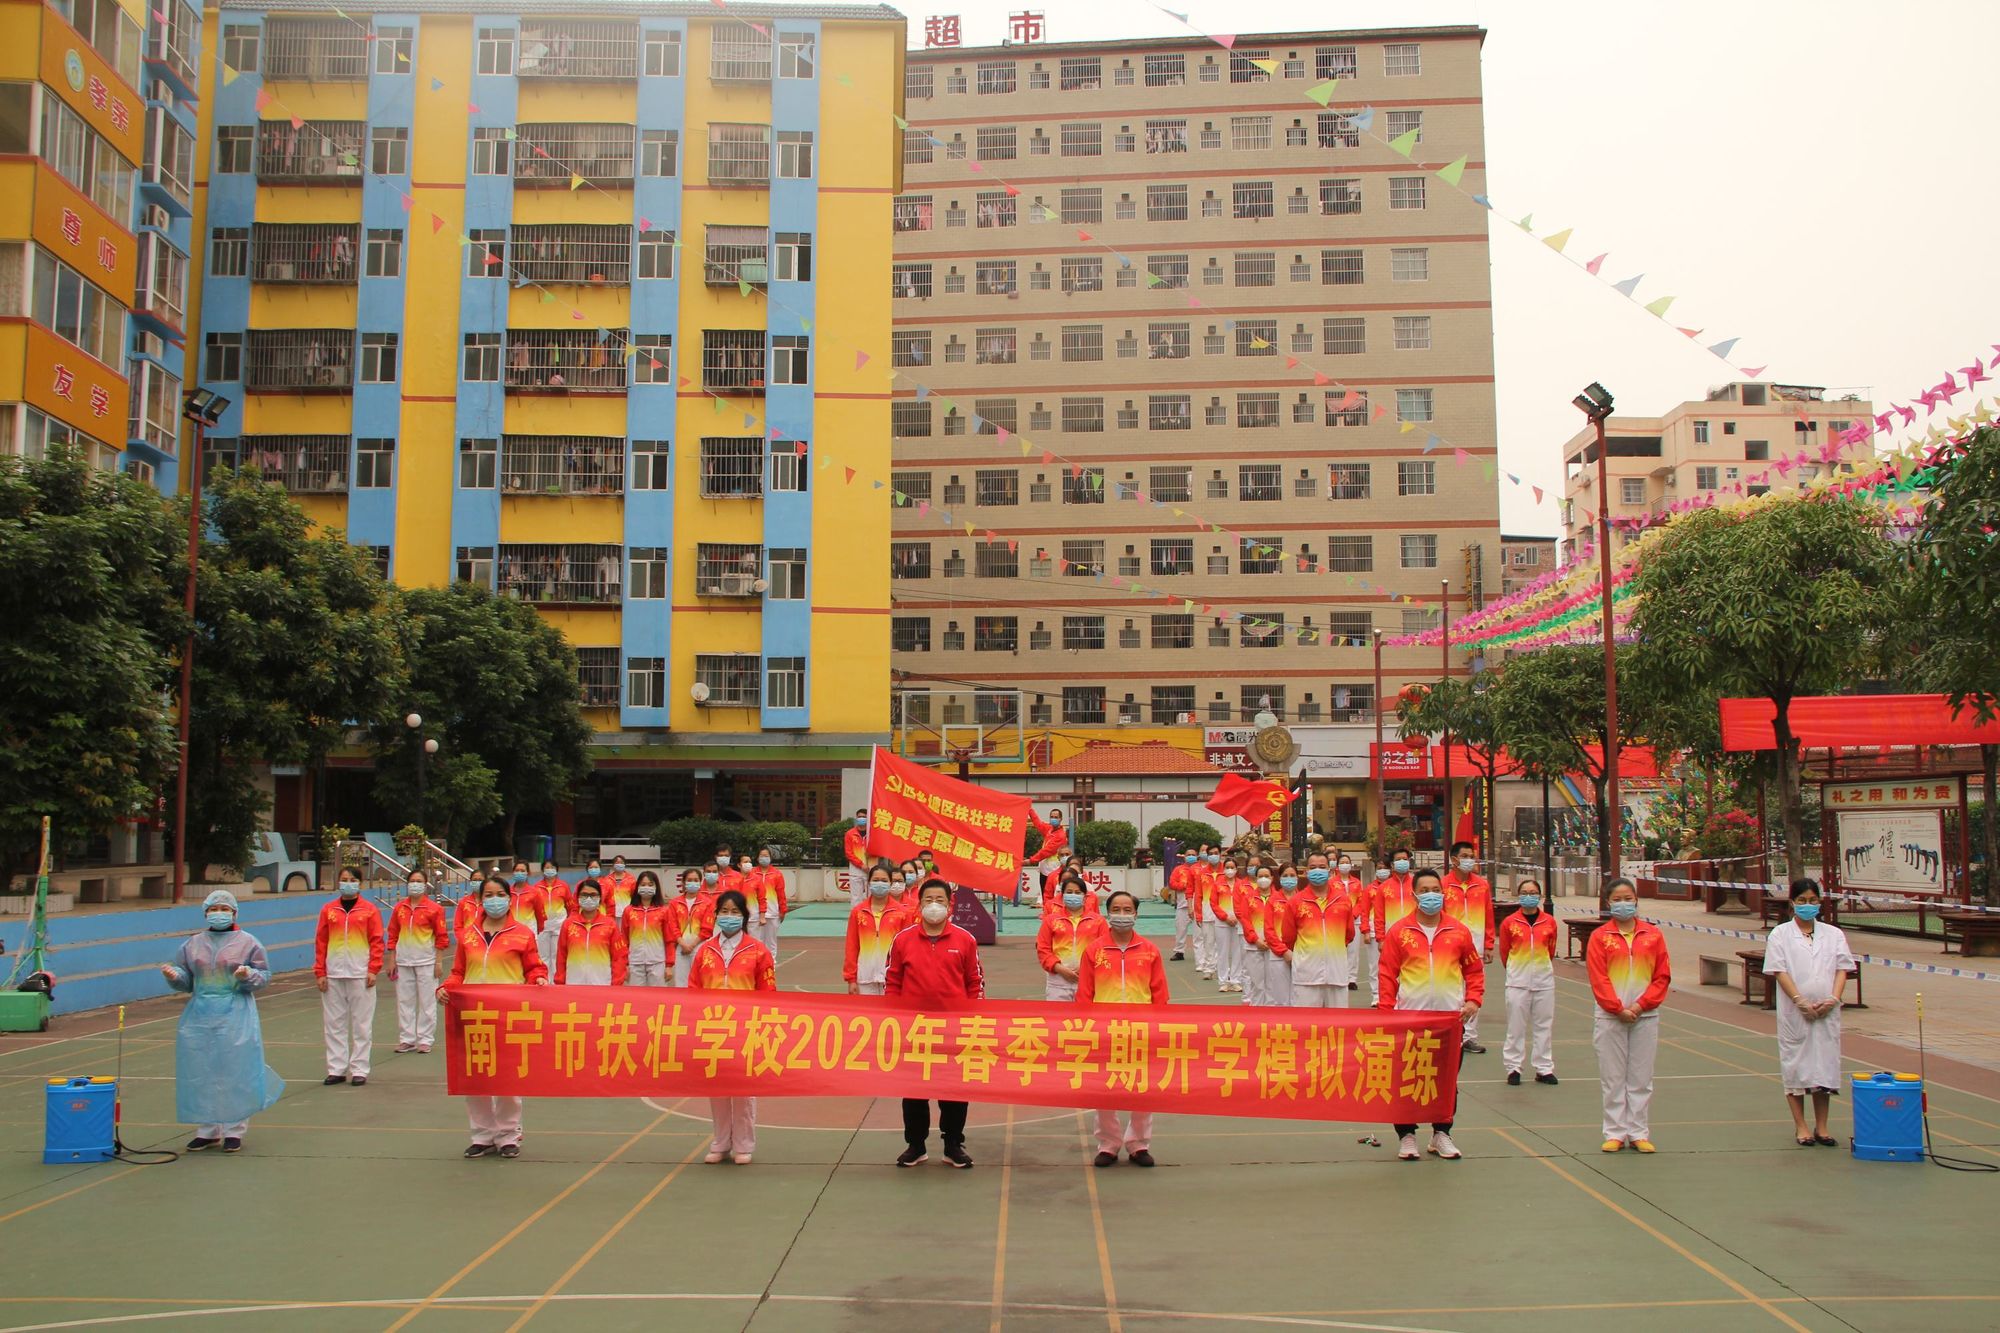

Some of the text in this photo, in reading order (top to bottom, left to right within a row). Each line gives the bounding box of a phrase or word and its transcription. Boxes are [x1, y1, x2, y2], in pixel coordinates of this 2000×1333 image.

[925, 10, 1043, 47] 超市
[62, 207, 118, 273] 尊师
[53, 363, 109, 418] 友学
[1208, 731, 1235, 743] M&G
[1209, 752, 1253, 767] 非迪文
[873, 808, 1015, 873] 党员志愿服务队
[460, 1001, 1442, 1106] 南宁市扶壮学校2020年春季学期开学模拟演练
